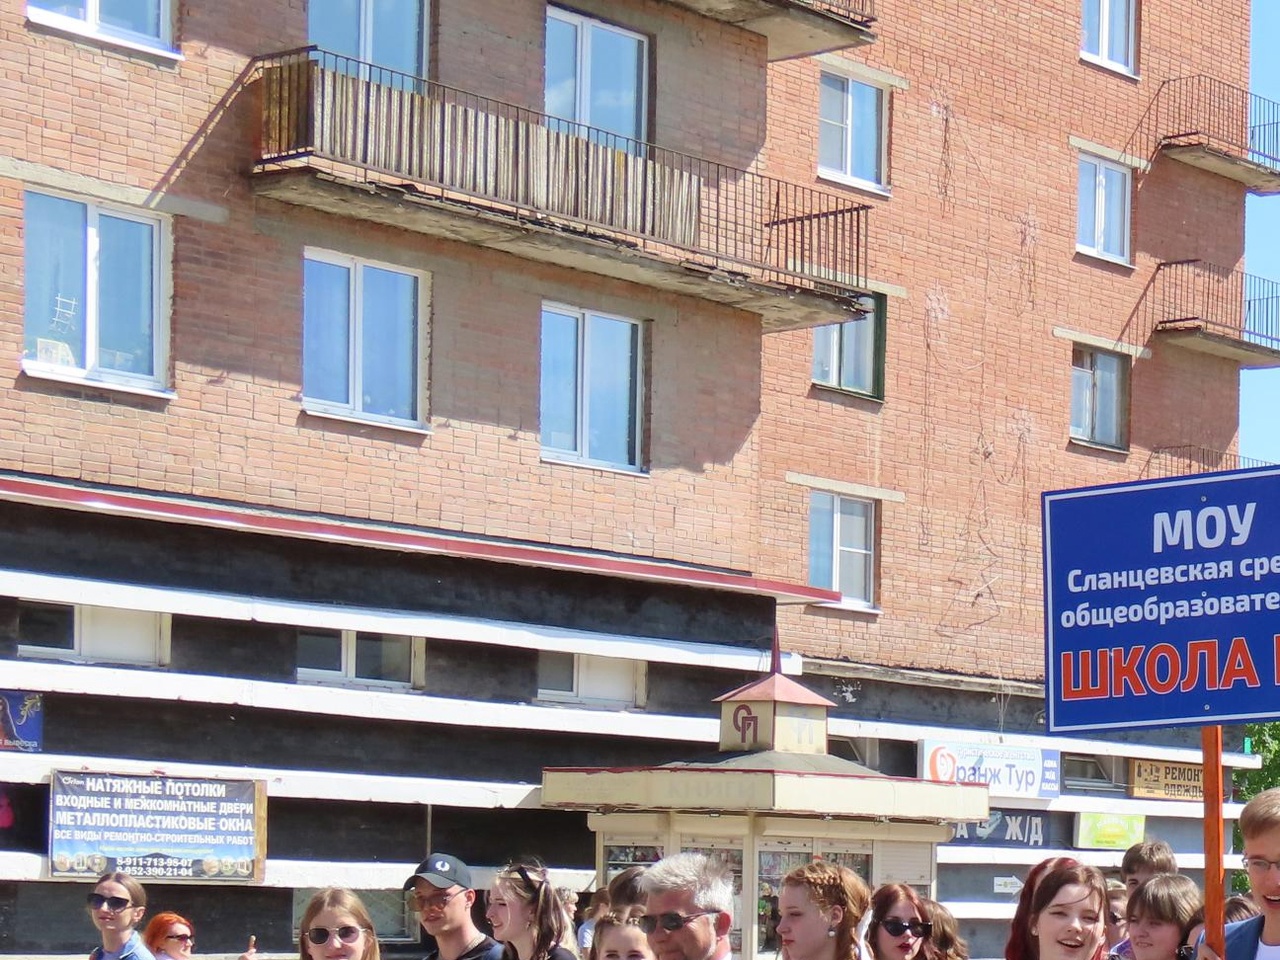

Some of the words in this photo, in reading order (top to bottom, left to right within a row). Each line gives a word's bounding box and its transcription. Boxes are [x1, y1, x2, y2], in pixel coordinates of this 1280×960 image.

[1152, 501, 1257, 553] МОУ
[1066, 560, 1234, 594] Сланцевская
[1060, 636, 1262, 702] ШКОЛА
[86, 777, 163, 795] НАТЯЖНЫЕ
[165, 779, 226, 798] ПОТОЛКИ
[1004, 763, 1036, 793] Тур
[56, 794, 111, 809] ВХОДНЫЕ
[114, 797, 122, 809] И
[124, 797, 217, 814] МЕЖКОМНАТНЫЕ
[219, 802, 254, 815] ДВЕРИ
[56, 811, 216, 831] МЕТАЛЛОПЛАСТИКОВЫЕ
[219, 817, 253, 831] ОКНА
[1004, 815, 1044, 846] Ж/Д
[54, 829, 72, 840] ВСЕ
[74, 830, 102, 841] ВИДЫ
[104, 831, 225, 845] РЕМОНТНО-СТРОИТЕЛЬНЫХ
[226, 835, 254, 846] РАБОТ
